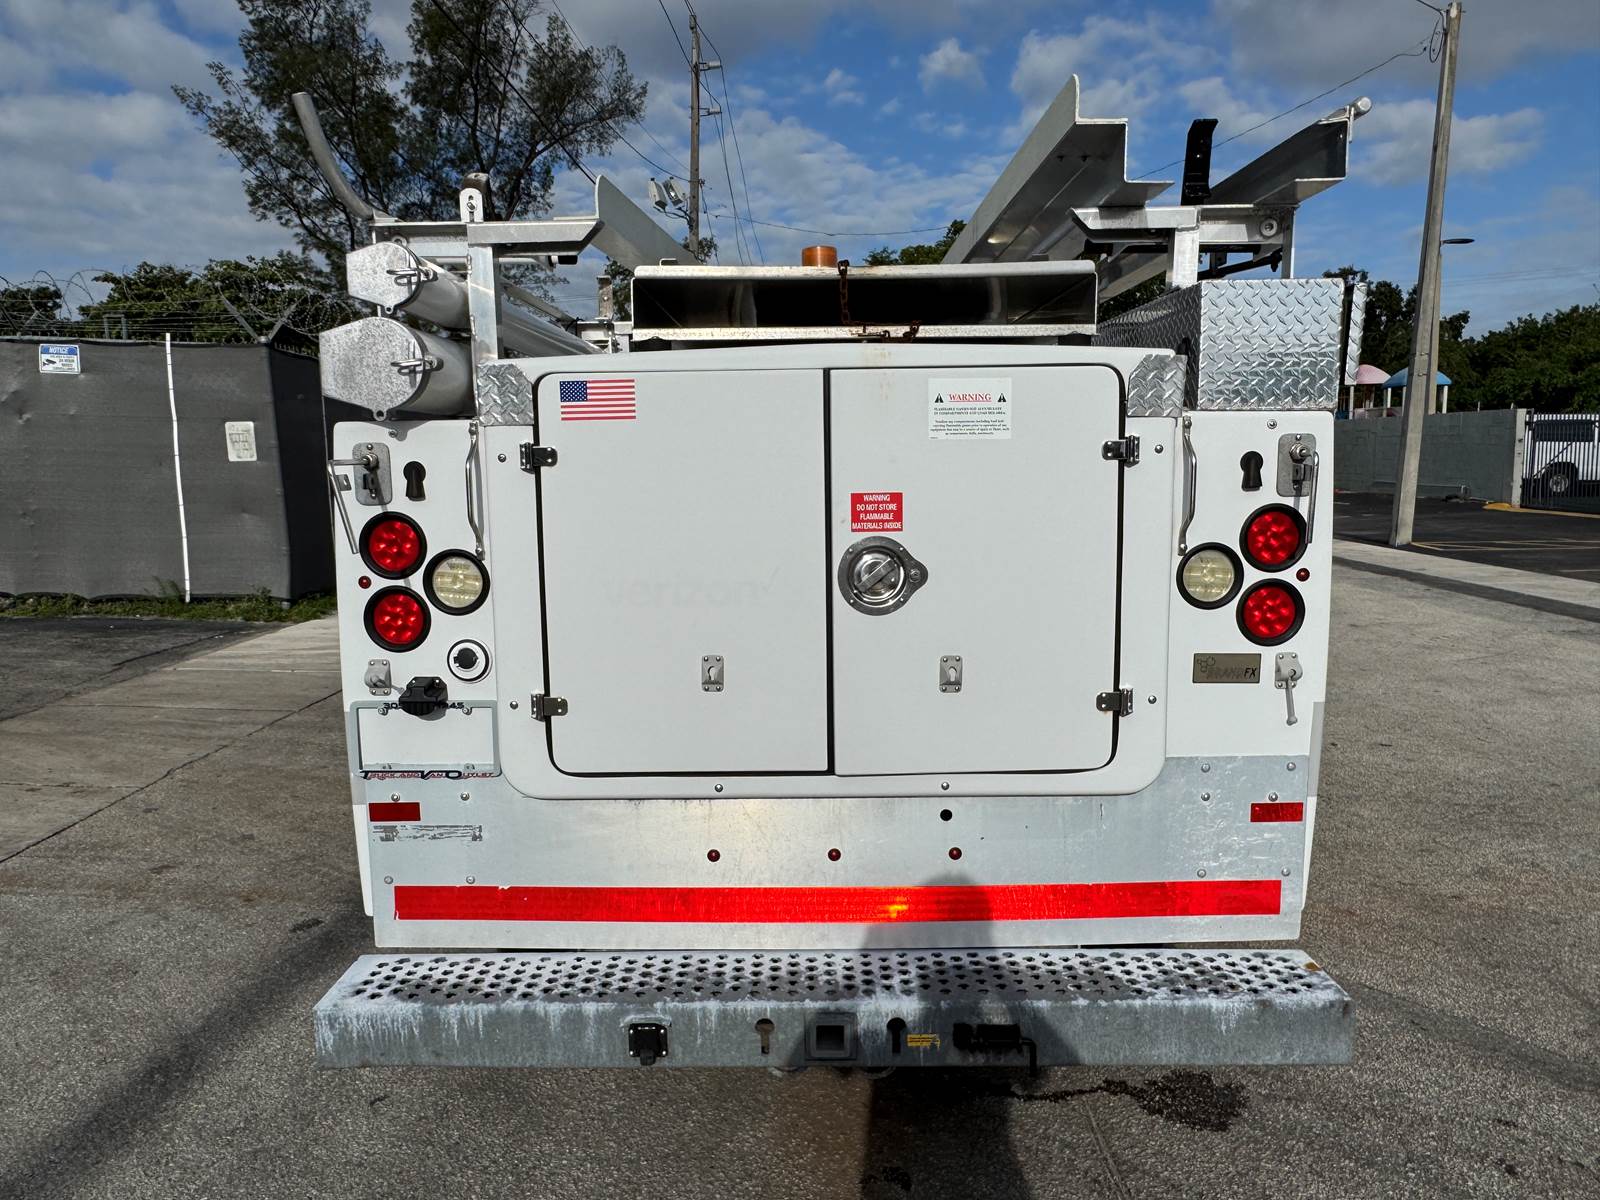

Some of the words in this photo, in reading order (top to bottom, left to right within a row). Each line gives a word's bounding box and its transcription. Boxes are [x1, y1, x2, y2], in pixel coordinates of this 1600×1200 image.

[948, 393, 992, 402] WARNING
[856, 503, 865, 511] DO
[866, 503, 878, 511] NOT
[879, 503, 898, 511] STORE
[859, 512, 894, 520] FLAMMABLE
[852, 522, 883, 530] MATERIALS
[883, 521, 902, 529] INSIDE
